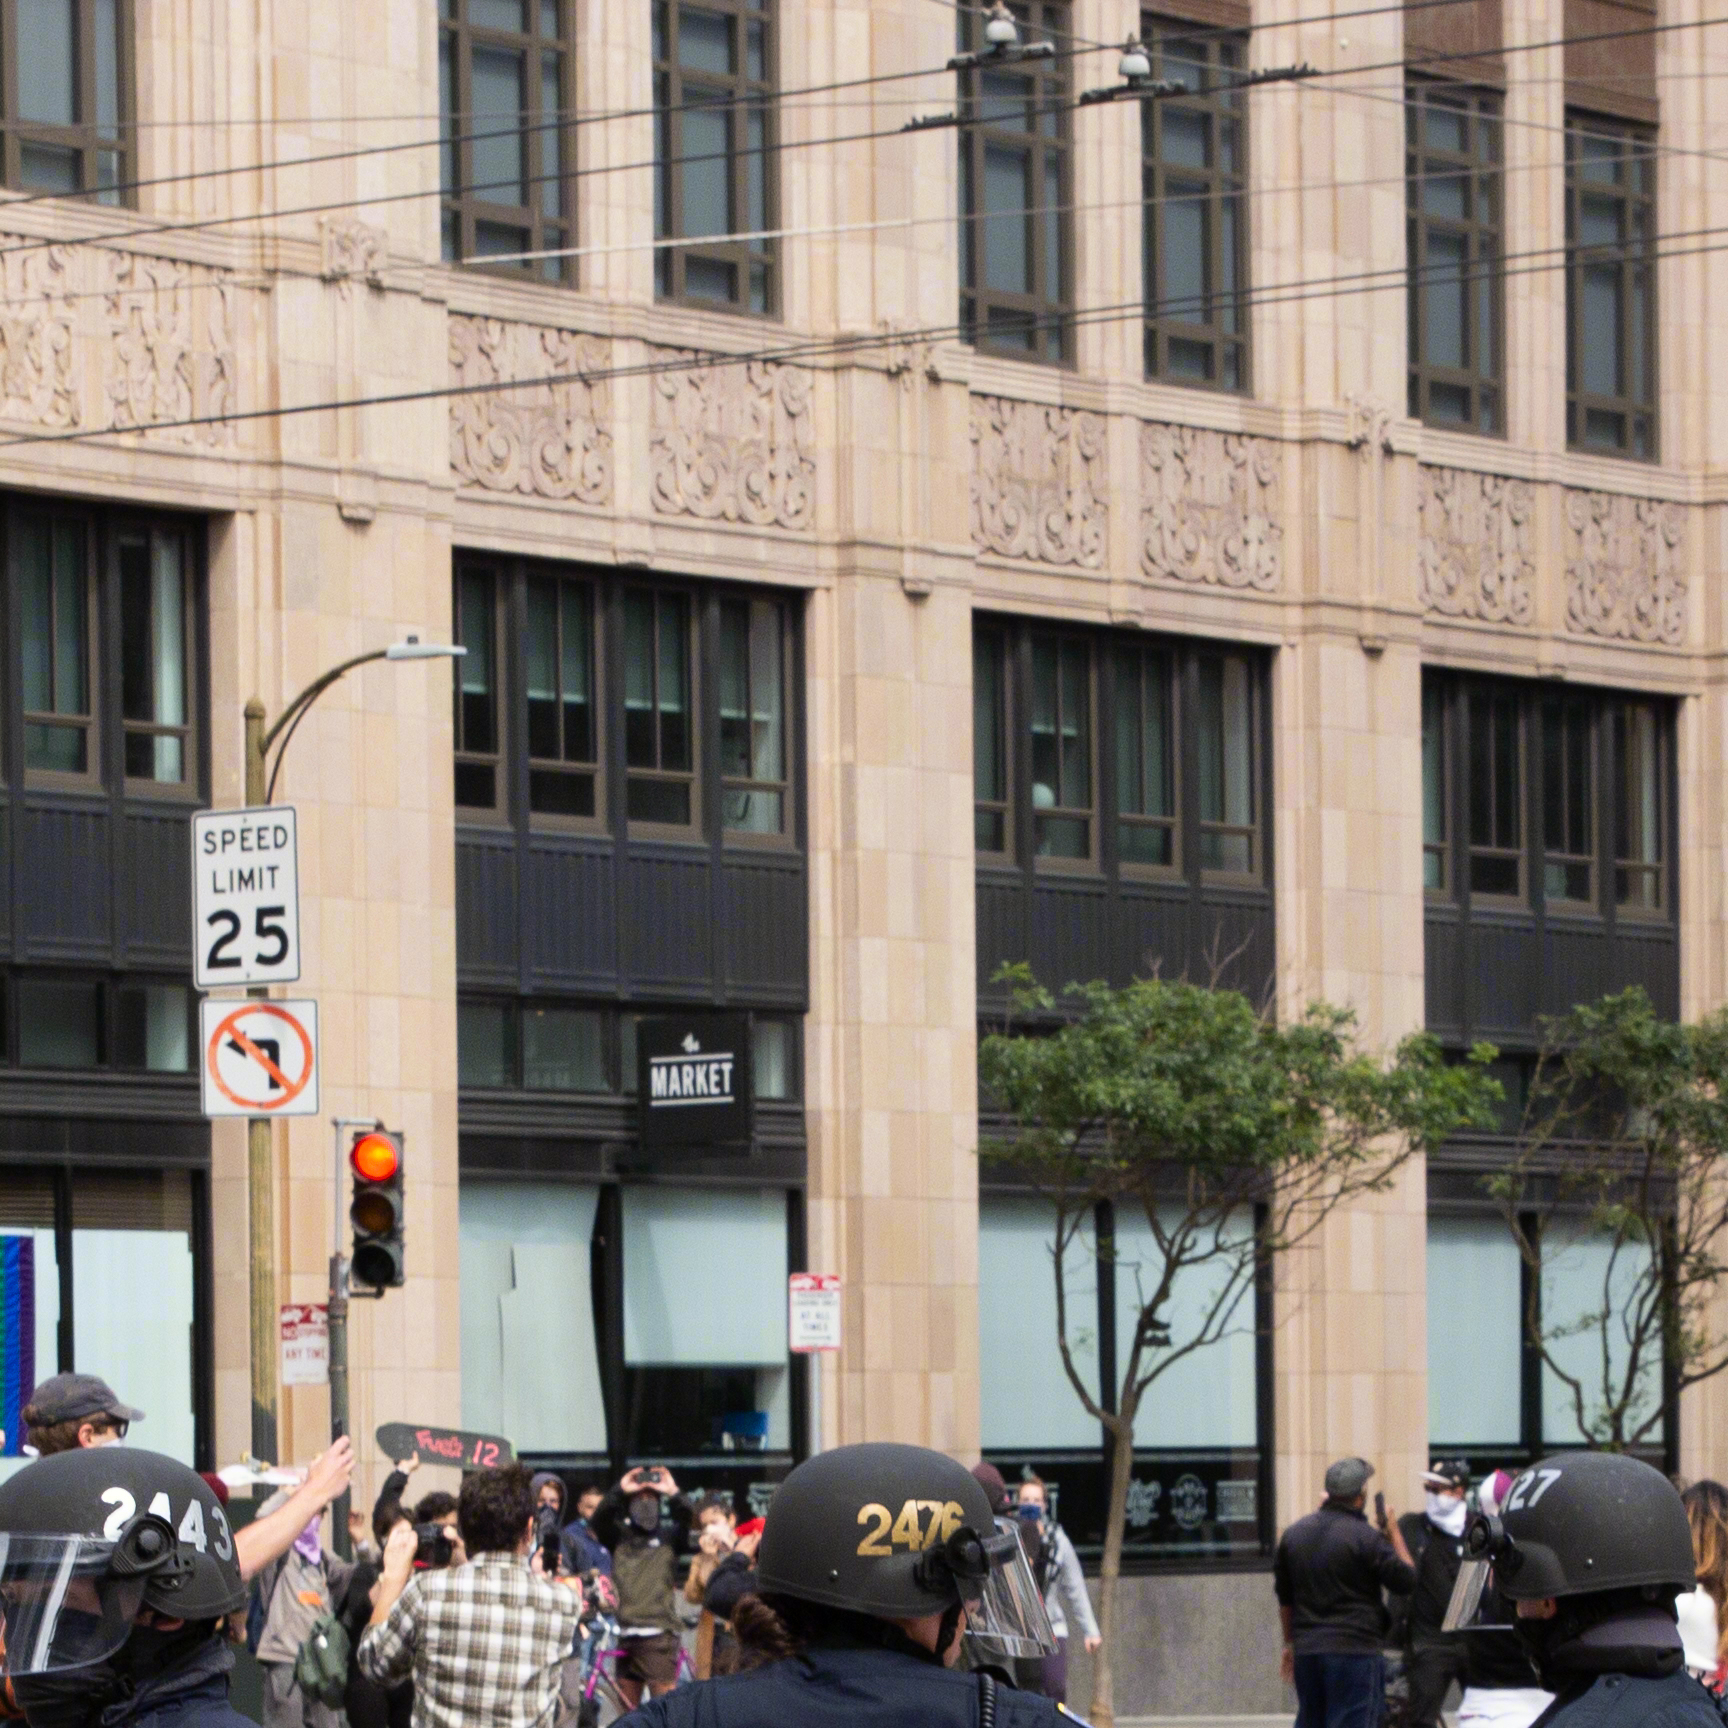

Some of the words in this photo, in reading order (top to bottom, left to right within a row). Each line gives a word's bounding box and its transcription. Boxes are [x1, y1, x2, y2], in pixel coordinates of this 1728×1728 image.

[204, 825, 288, 854] SPEED
[212, 866, 279, 893] LIMIT
[207, 905, 289, 969] 25
[651, 1062, 733, 1098] MARKET
[472, 1439, 499, 1467] 12
